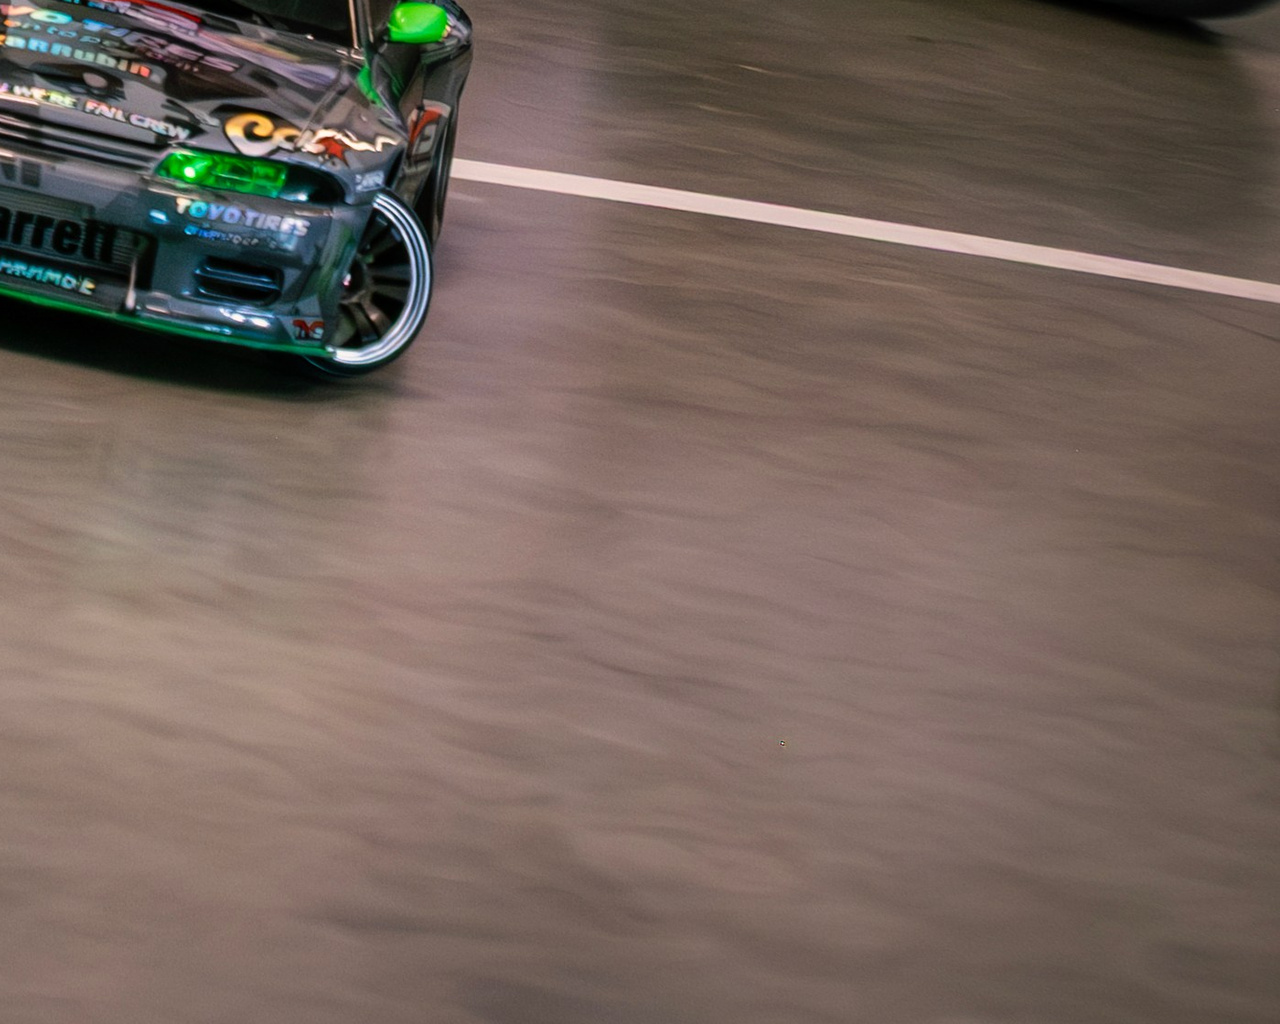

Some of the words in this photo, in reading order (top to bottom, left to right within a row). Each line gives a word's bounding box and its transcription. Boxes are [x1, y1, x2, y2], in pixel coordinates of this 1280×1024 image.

[81, 18, 241, 73] TIRES
[176, 196, 242, 225] TOYO
[242, 206, 312, 237] TIRES
